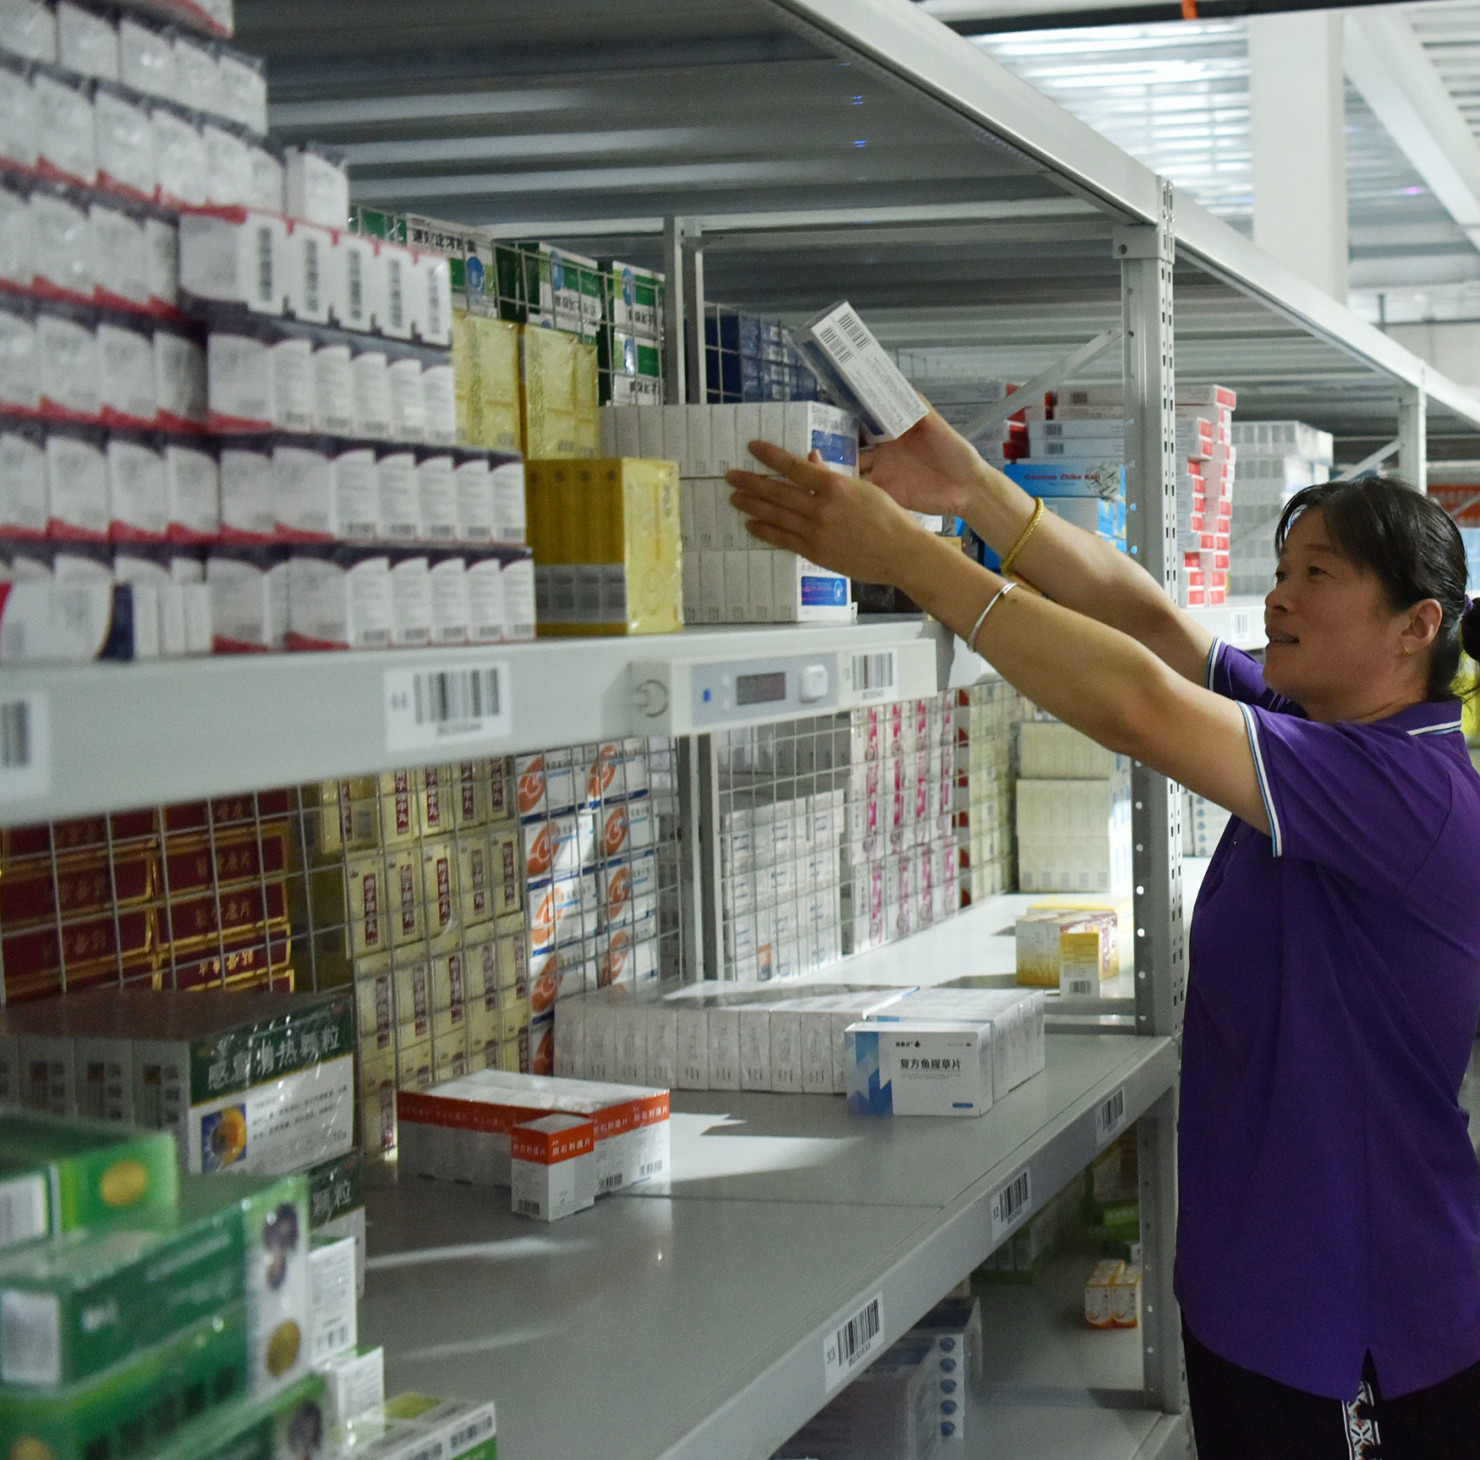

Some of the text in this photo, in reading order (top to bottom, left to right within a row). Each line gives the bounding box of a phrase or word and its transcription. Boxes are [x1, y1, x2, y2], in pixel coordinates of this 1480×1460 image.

[900, 1058, 961, 1070] 复方鱼腥草片
